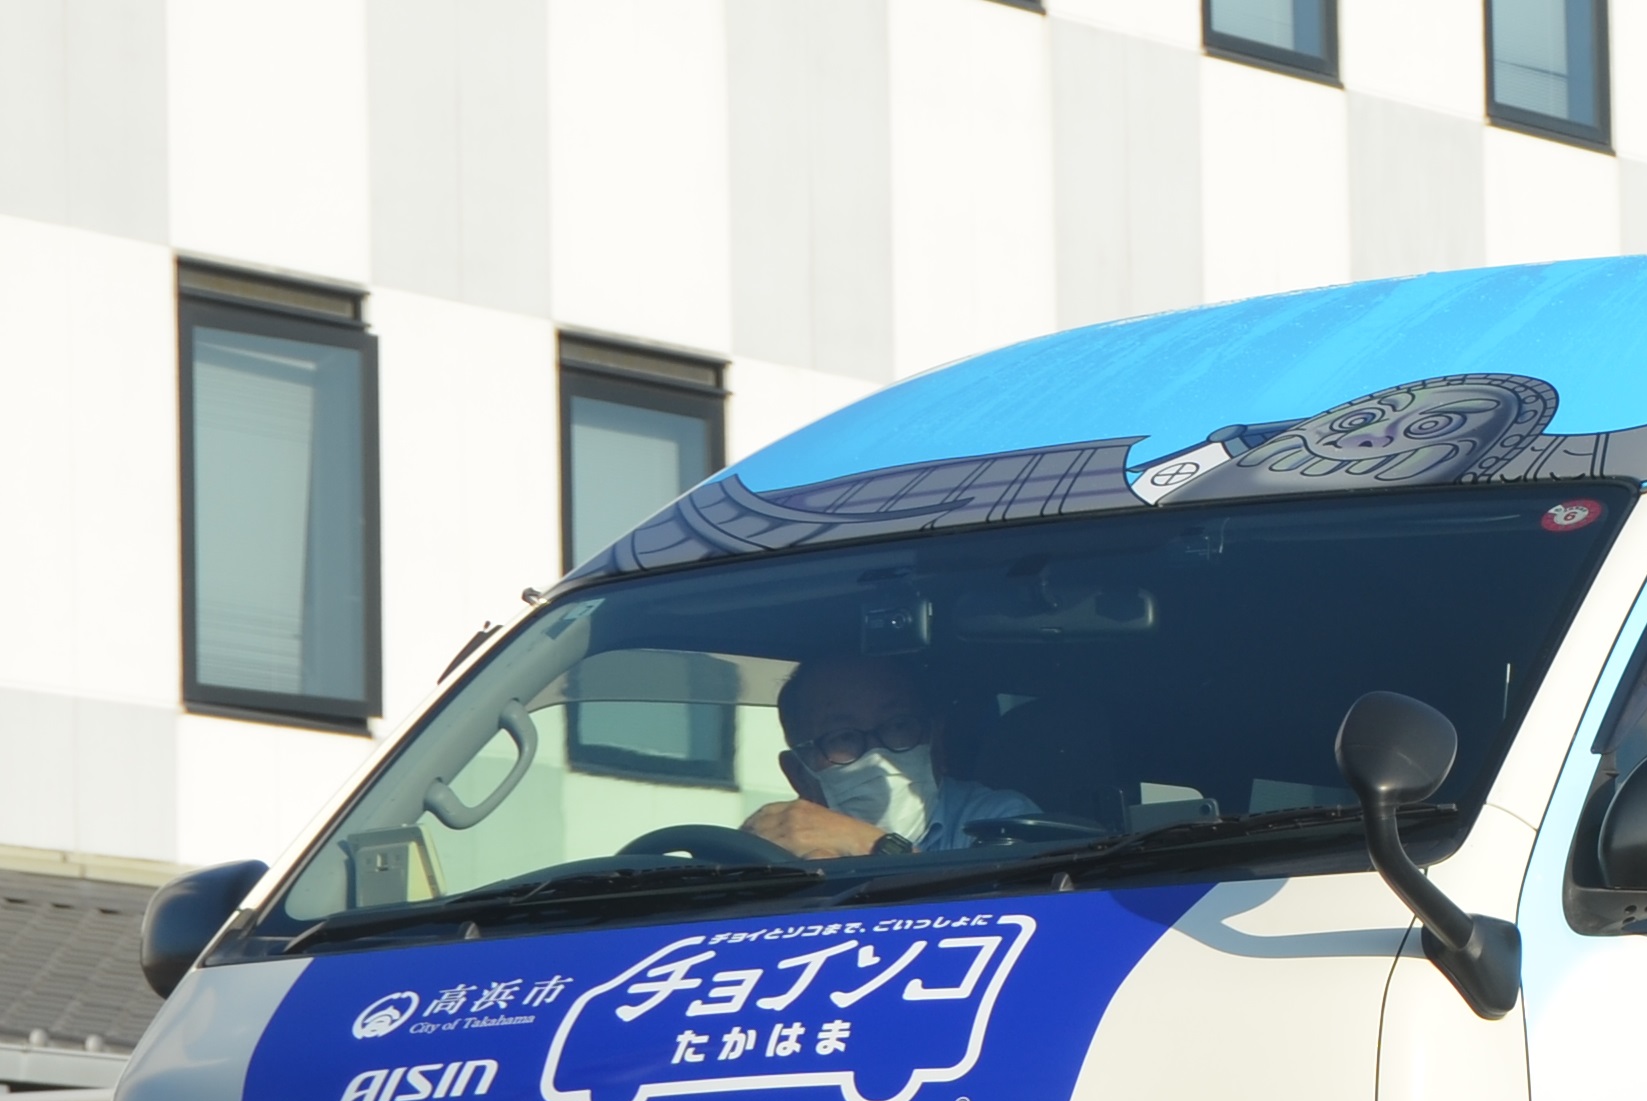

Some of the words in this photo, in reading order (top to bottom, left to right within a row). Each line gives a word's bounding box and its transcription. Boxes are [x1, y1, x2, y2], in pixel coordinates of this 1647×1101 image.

[422, 975, 575, 1018] 高浜市
[615, 935, 1003, 1022] チョイソコ
[409, 1021, 441, 1035] City
[441, 1017, 460, 1031] of
[463, 1014, 537, 1029] Takahama
[670, 1019, 852, 1064] たかはま
